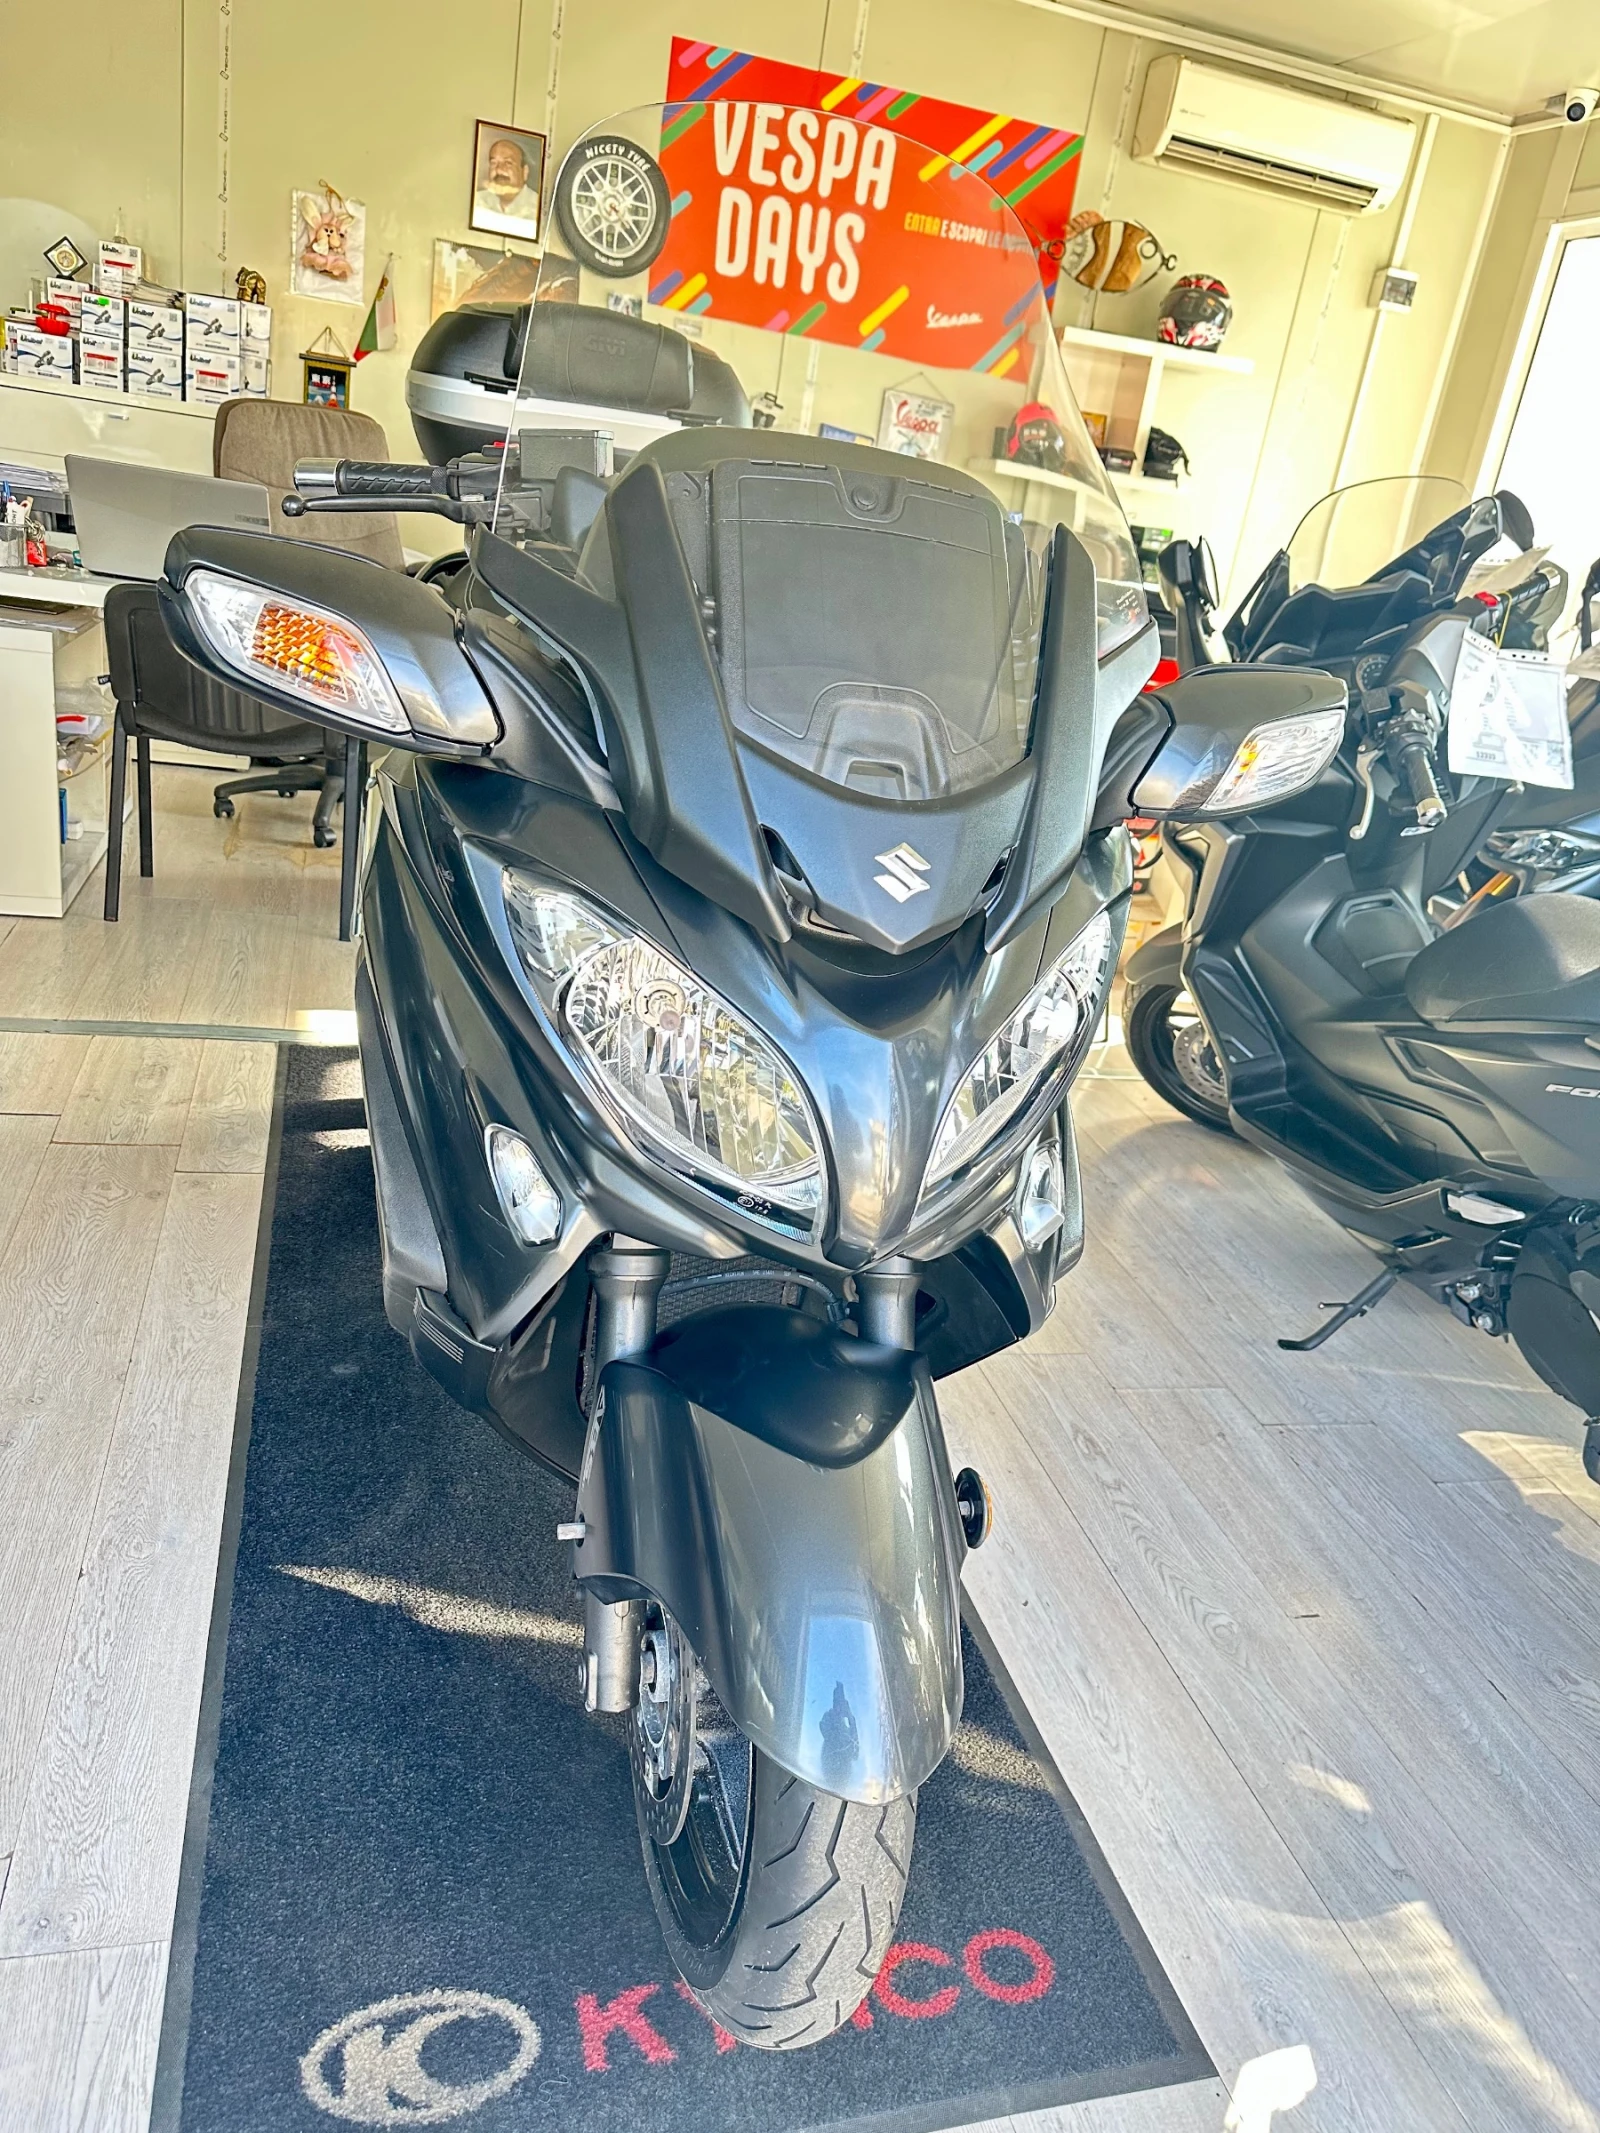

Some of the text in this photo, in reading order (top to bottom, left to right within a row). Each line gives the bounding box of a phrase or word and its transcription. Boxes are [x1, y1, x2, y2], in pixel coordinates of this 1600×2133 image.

[585, 143, 651, 172] NICETY TYRE
[713, 101, 897, 211] VESPA
[714, 186, 866, 304] DAYS
[904, 212, 941, 237] ENTRA
[940, 219, 949, 238] E
[948, 221, 989, 247] SCOPRI
[895, 399, 940, 435] Vespa
[1544, 1083, 1600, 1099] FO
[574, 1926, 1056, 2072] KCO
